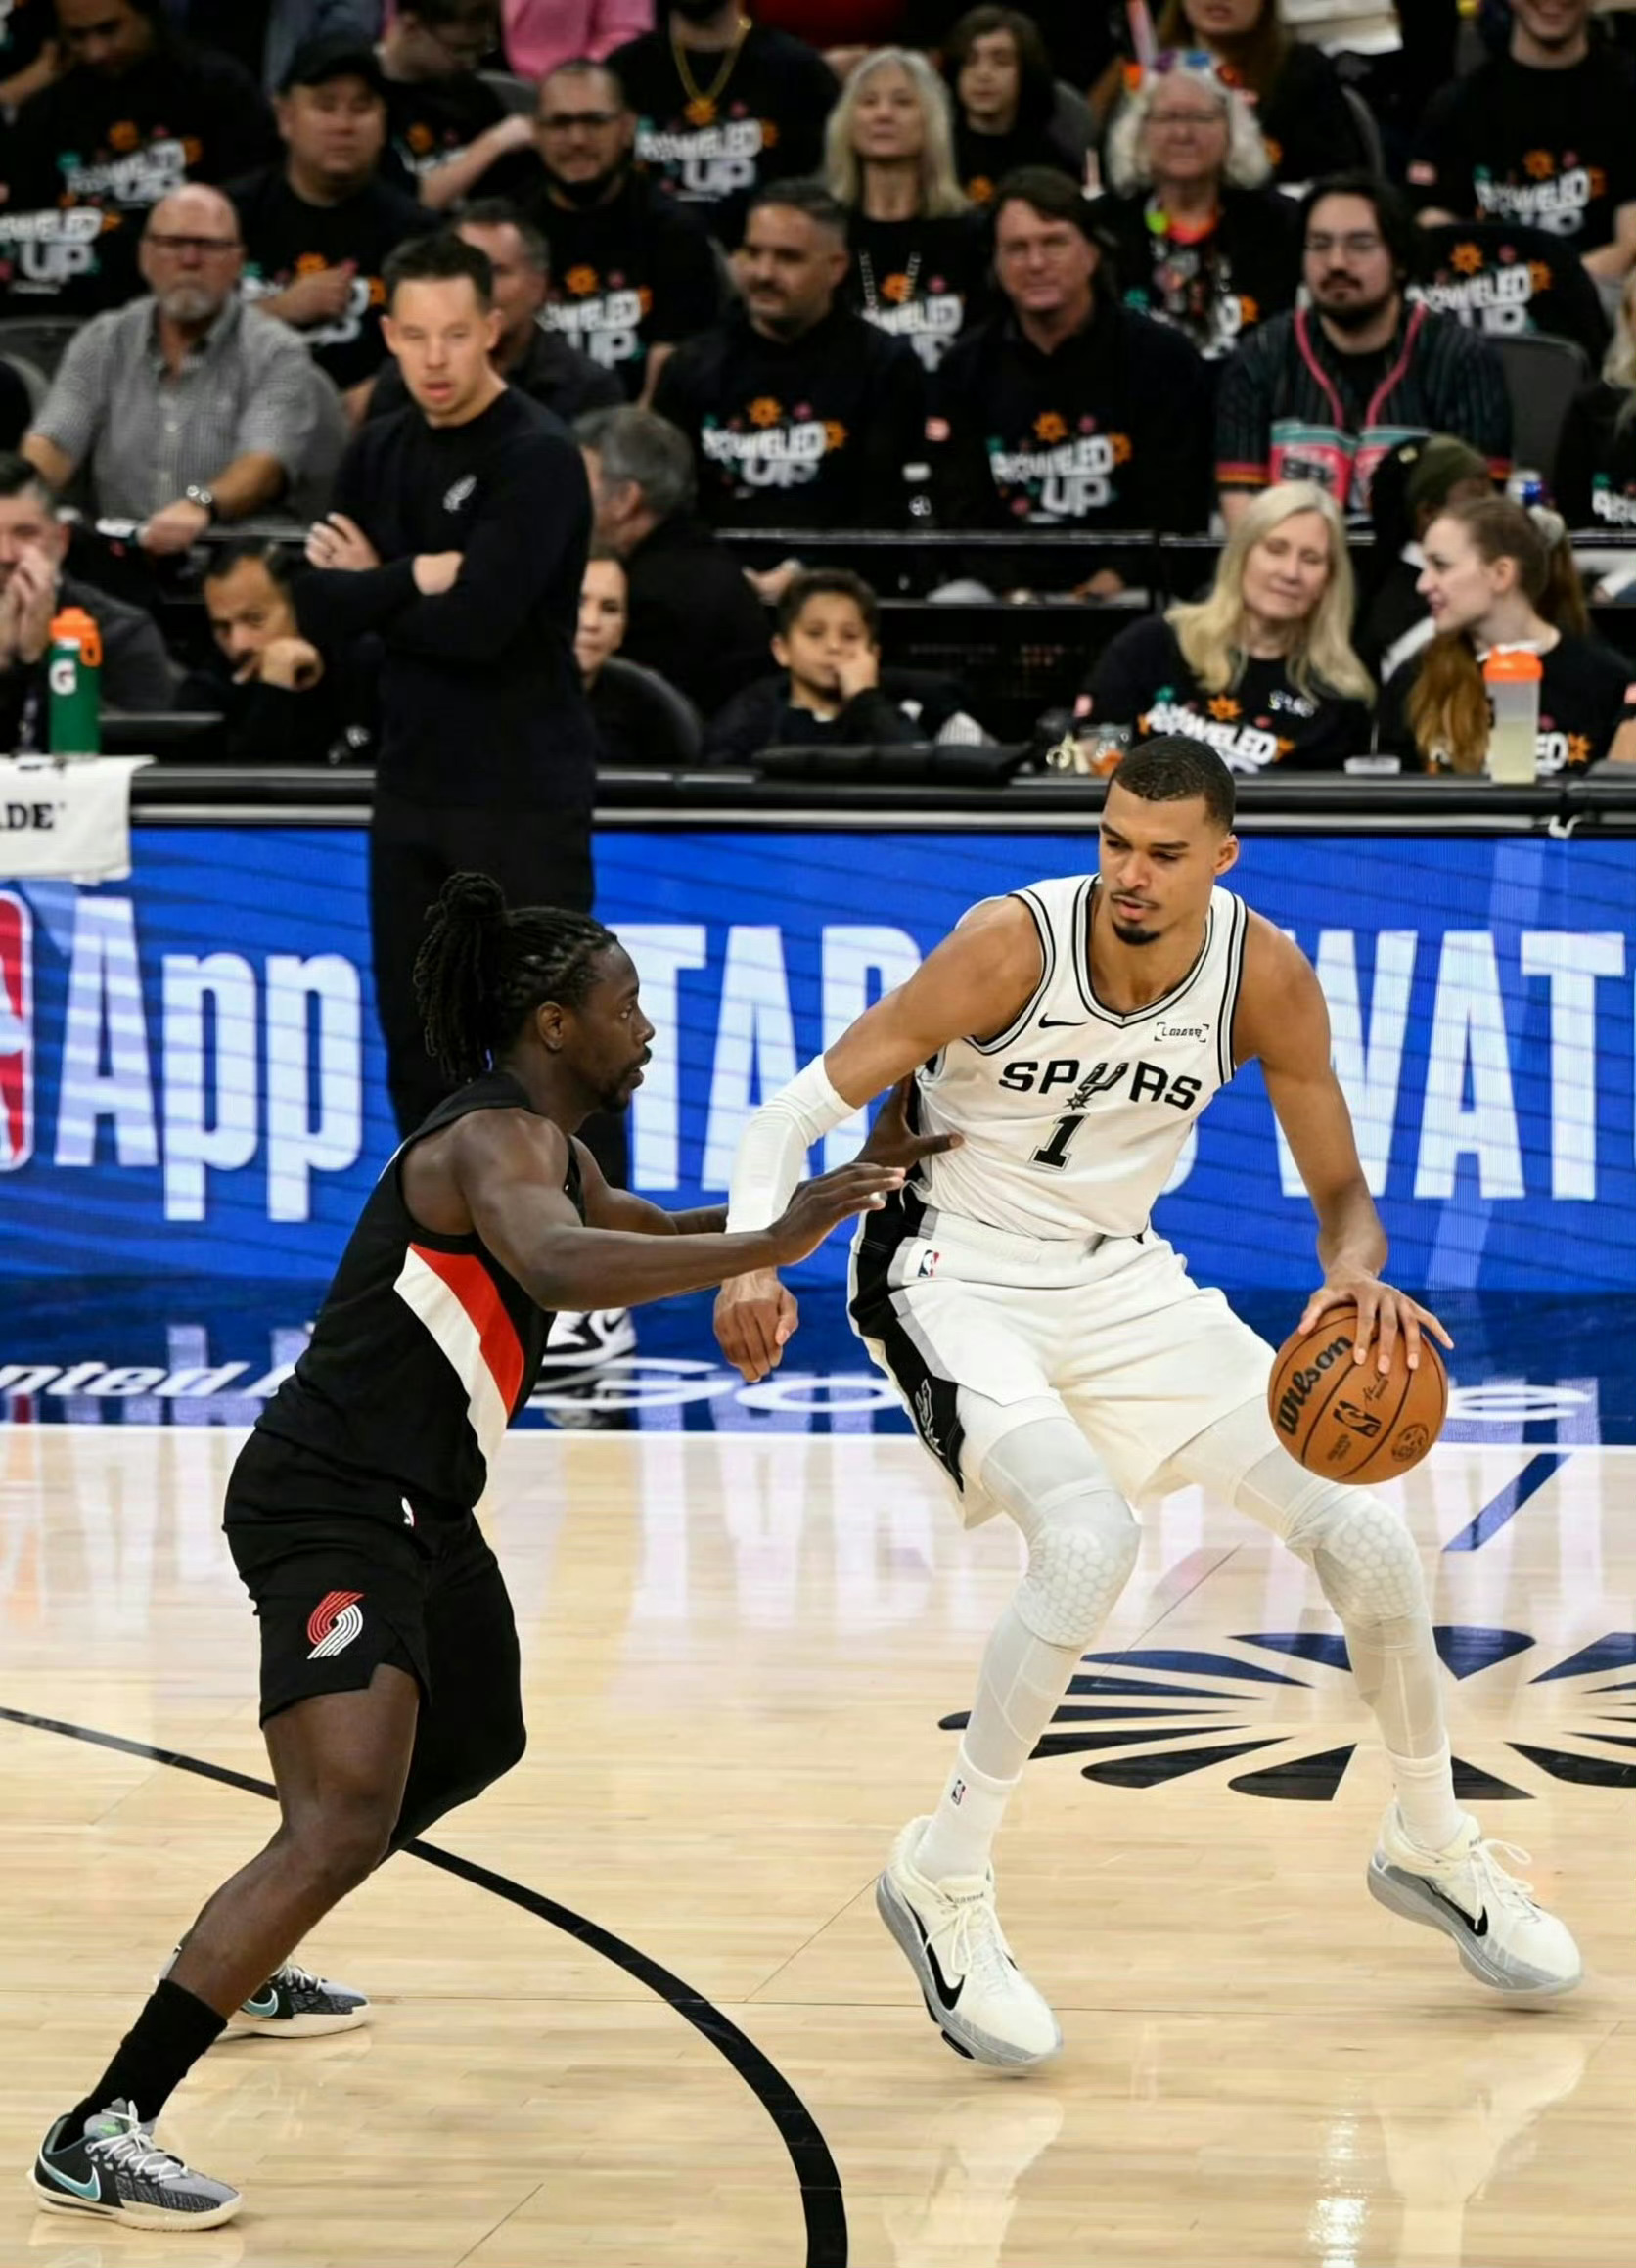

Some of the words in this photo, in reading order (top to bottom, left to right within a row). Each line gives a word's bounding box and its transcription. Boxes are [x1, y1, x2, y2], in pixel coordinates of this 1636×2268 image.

[682, 157, 756, 196] UP
[22, 241, 94, 283] UP
[743, 458, 820, 488] UP
[1041, 476, 1111, 517] UP
[50, 658, 77, 696] G
[0, 803, 54, 831] DE
[54, 897, 363, 1223] App
[1275, 930, 1636, 1201] WAT
[998, 1059, 1203, 1111] SPURS
[1028, 1112, 1088, 1173] 1
[1277, 1335, 1354, 1436] Wilson
